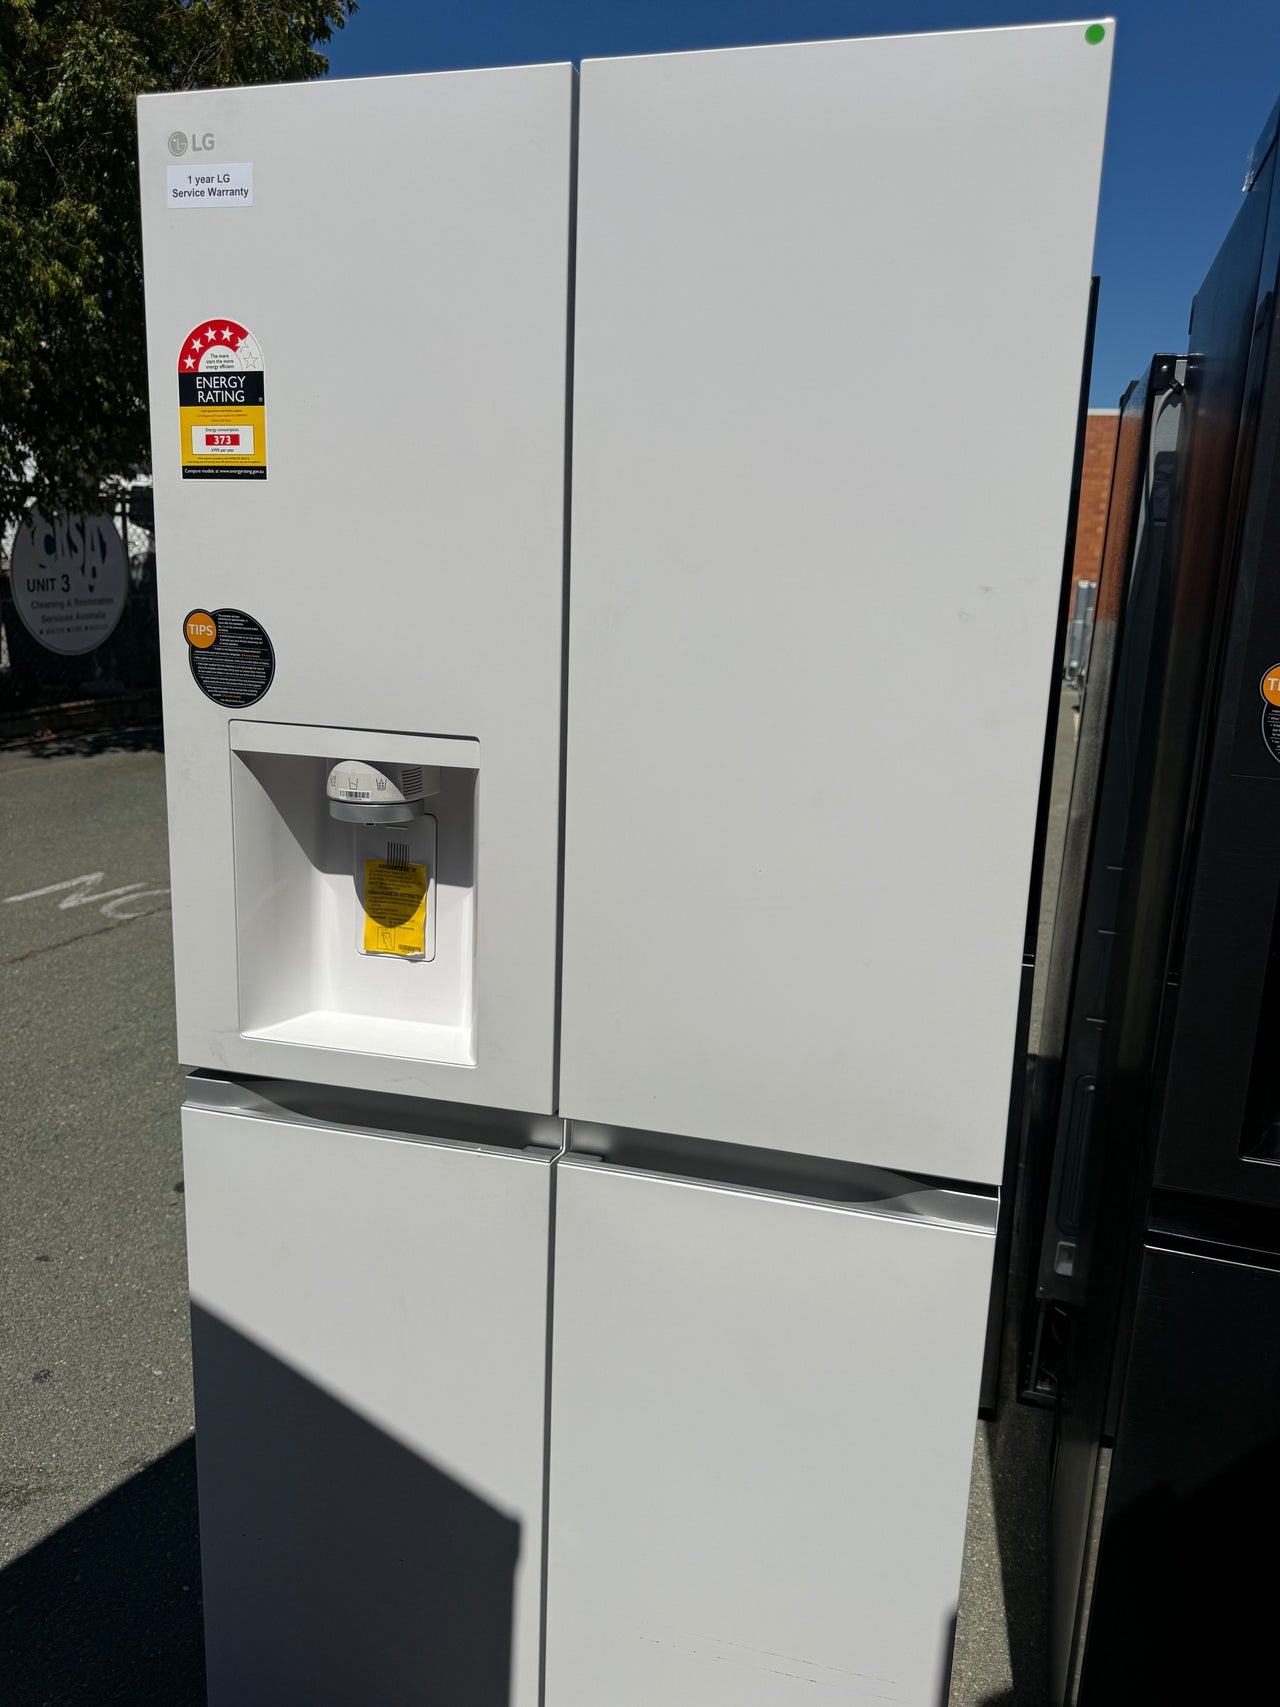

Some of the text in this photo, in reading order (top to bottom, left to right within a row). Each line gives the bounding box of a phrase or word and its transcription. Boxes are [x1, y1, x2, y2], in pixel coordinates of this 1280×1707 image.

[192, 133, 215, 152] LG
[188, 174, 230, 186] 1 year LG
[172, 187, 249, 198] Service Warranty
[196, 376, 246, 389] ENERGY
[197, 390, 245, 403] RATING
[213, 435, 232, 445] 373
[26, 574, 70, 593] UNIT 3
[30, 600, 65, 611] Cleaning
[66, 599, 73, 608] &
[41, 613, 74, 624] Services
[188, 624, 213, 636] TIPS
